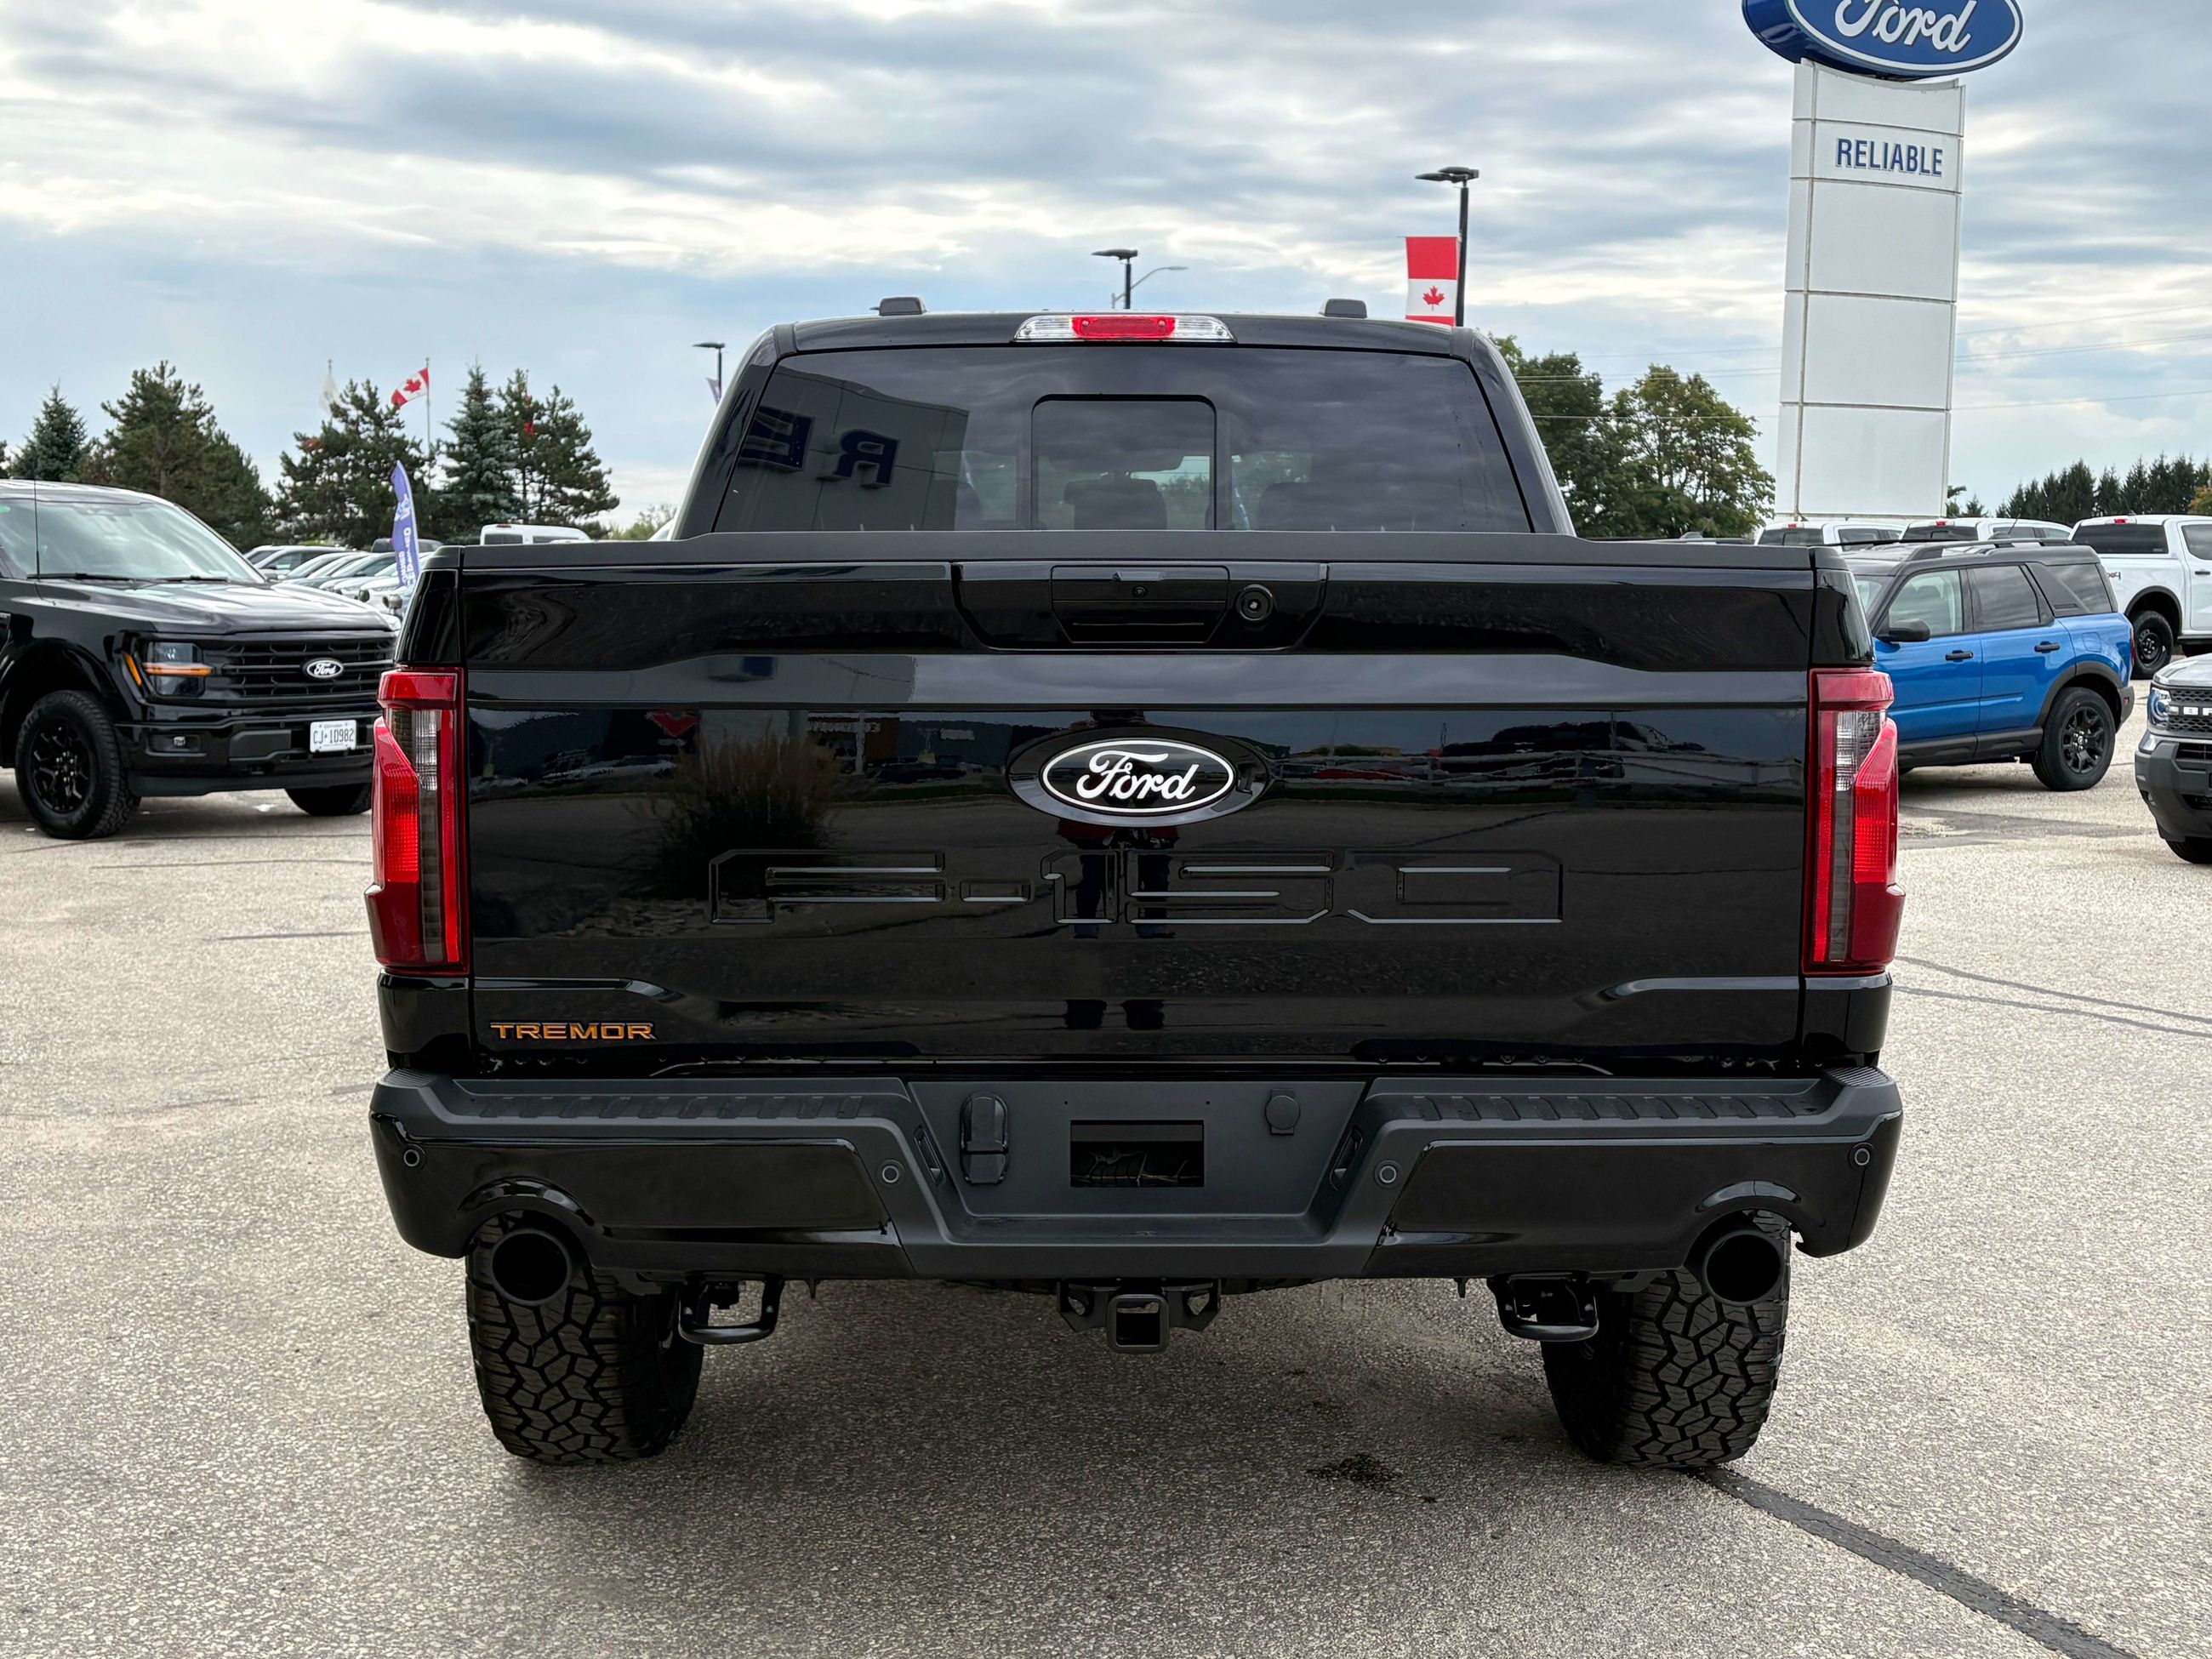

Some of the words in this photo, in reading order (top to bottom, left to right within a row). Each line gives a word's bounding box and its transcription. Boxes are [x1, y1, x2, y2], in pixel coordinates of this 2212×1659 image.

[1836, 138, 1943, 176] RELIABLE
[313, 663, 337, 675] Ford
[1076, 750, 1200, 800] Ford
[711, 850, 1564, 924] F-150
[490, 1022, 657, 1040] TREMOR
